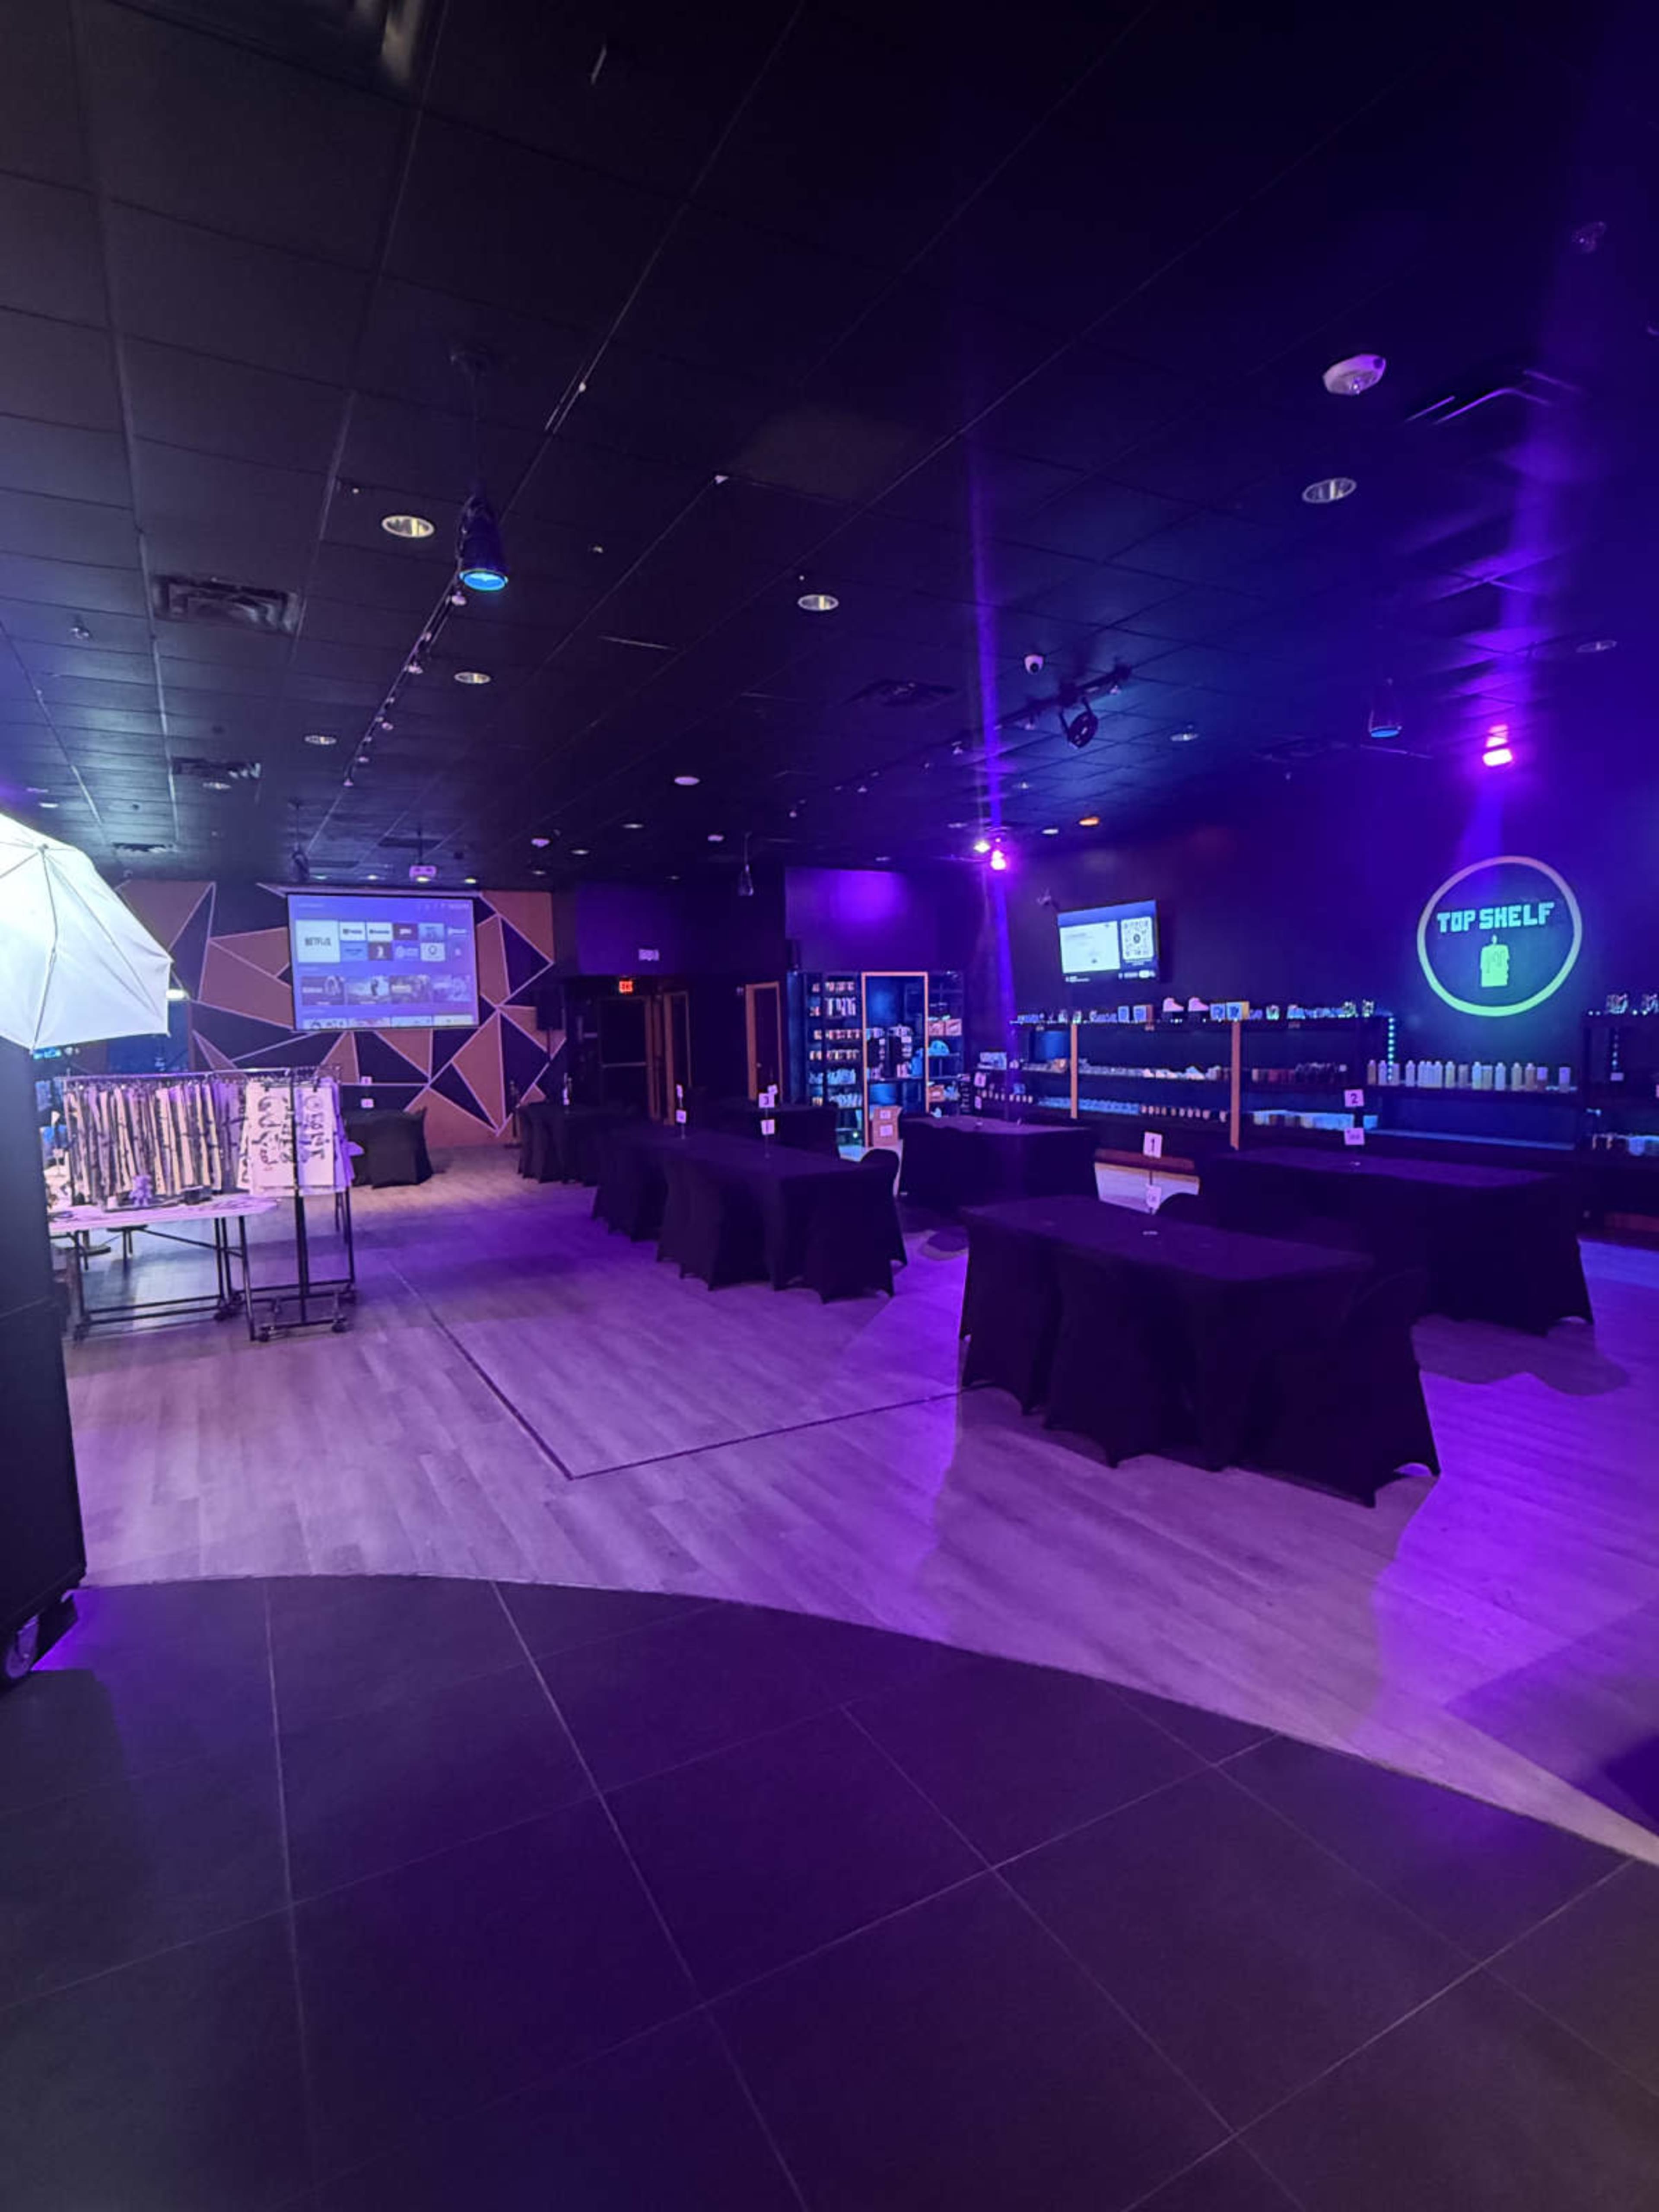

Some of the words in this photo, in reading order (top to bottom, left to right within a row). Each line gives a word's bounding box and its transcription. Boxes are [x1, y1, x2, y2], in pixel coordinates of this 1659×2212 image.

[1437, 909, 1476, 933] TOP
[1479, 902, 1555, 930] SHELF
[1350, 1093, 1358, 1104] 2
